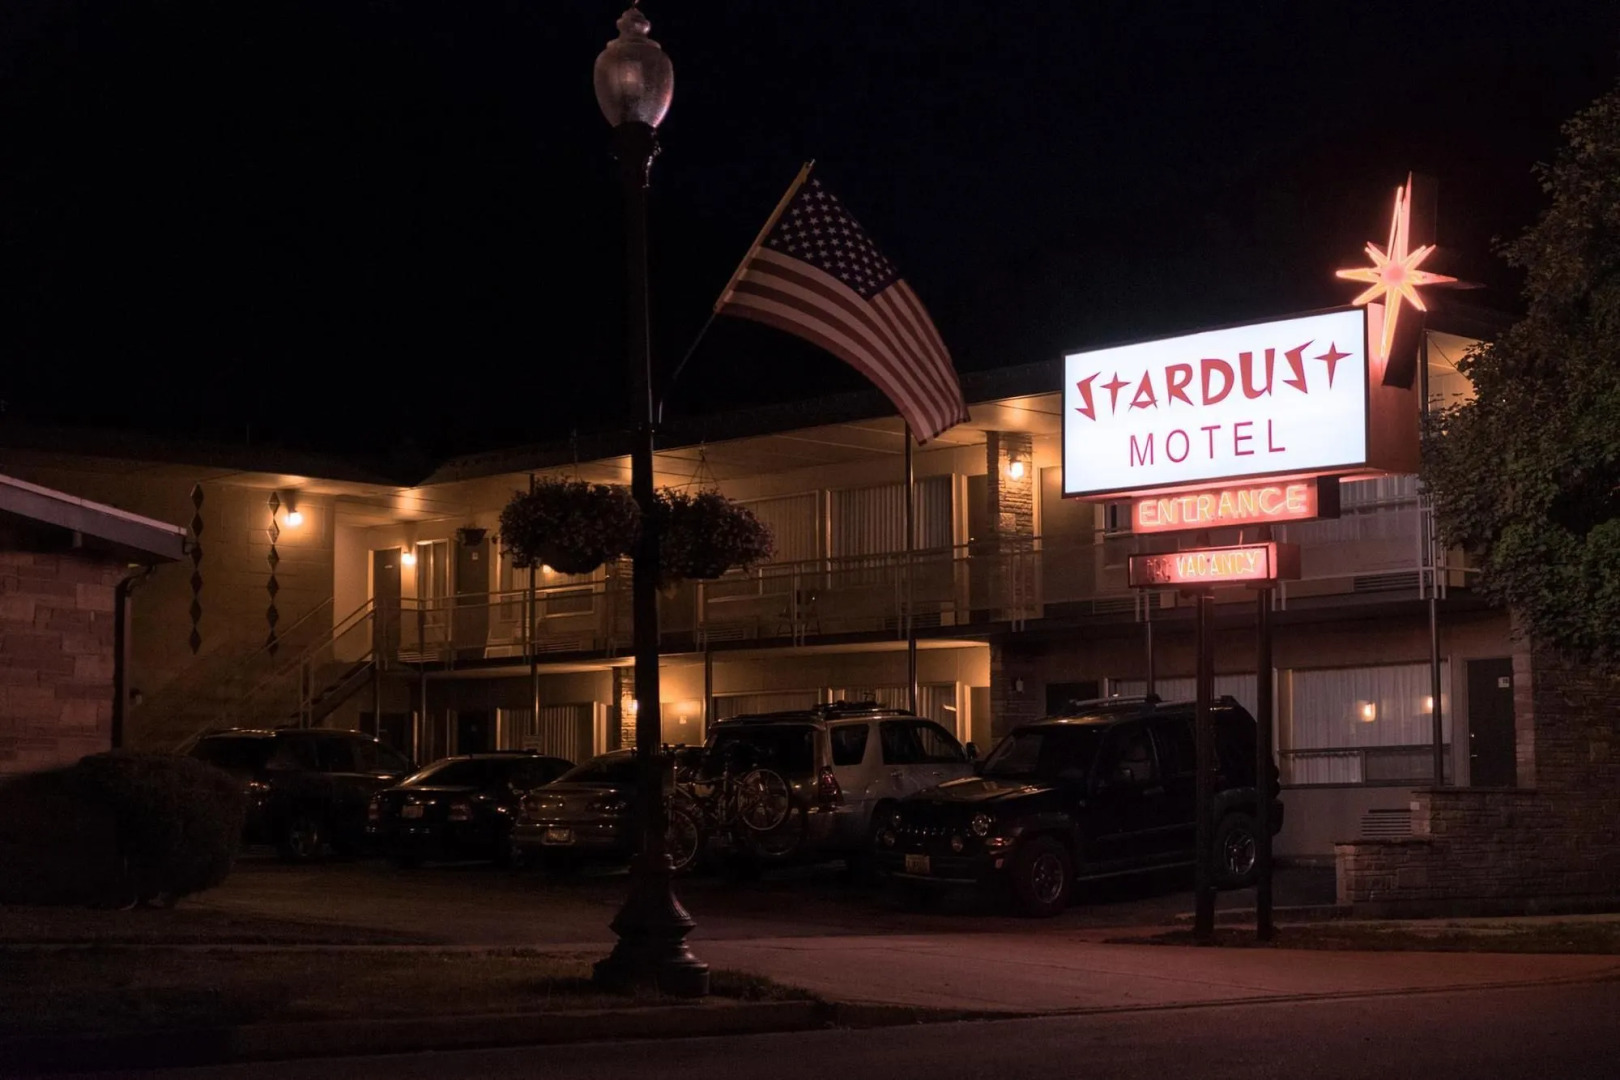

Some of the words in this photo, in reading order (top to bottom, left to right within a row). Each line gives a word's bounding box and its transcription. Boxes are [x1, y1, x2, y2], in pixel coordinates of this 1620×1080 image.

[1074, 339, 1354, 421] STARDUST
[1129, 419, 1286, 467] MOTEL
[1138, 484, 1308, 527] ENTRANCE
[1176, 549, 1262, 579] VACANCY
